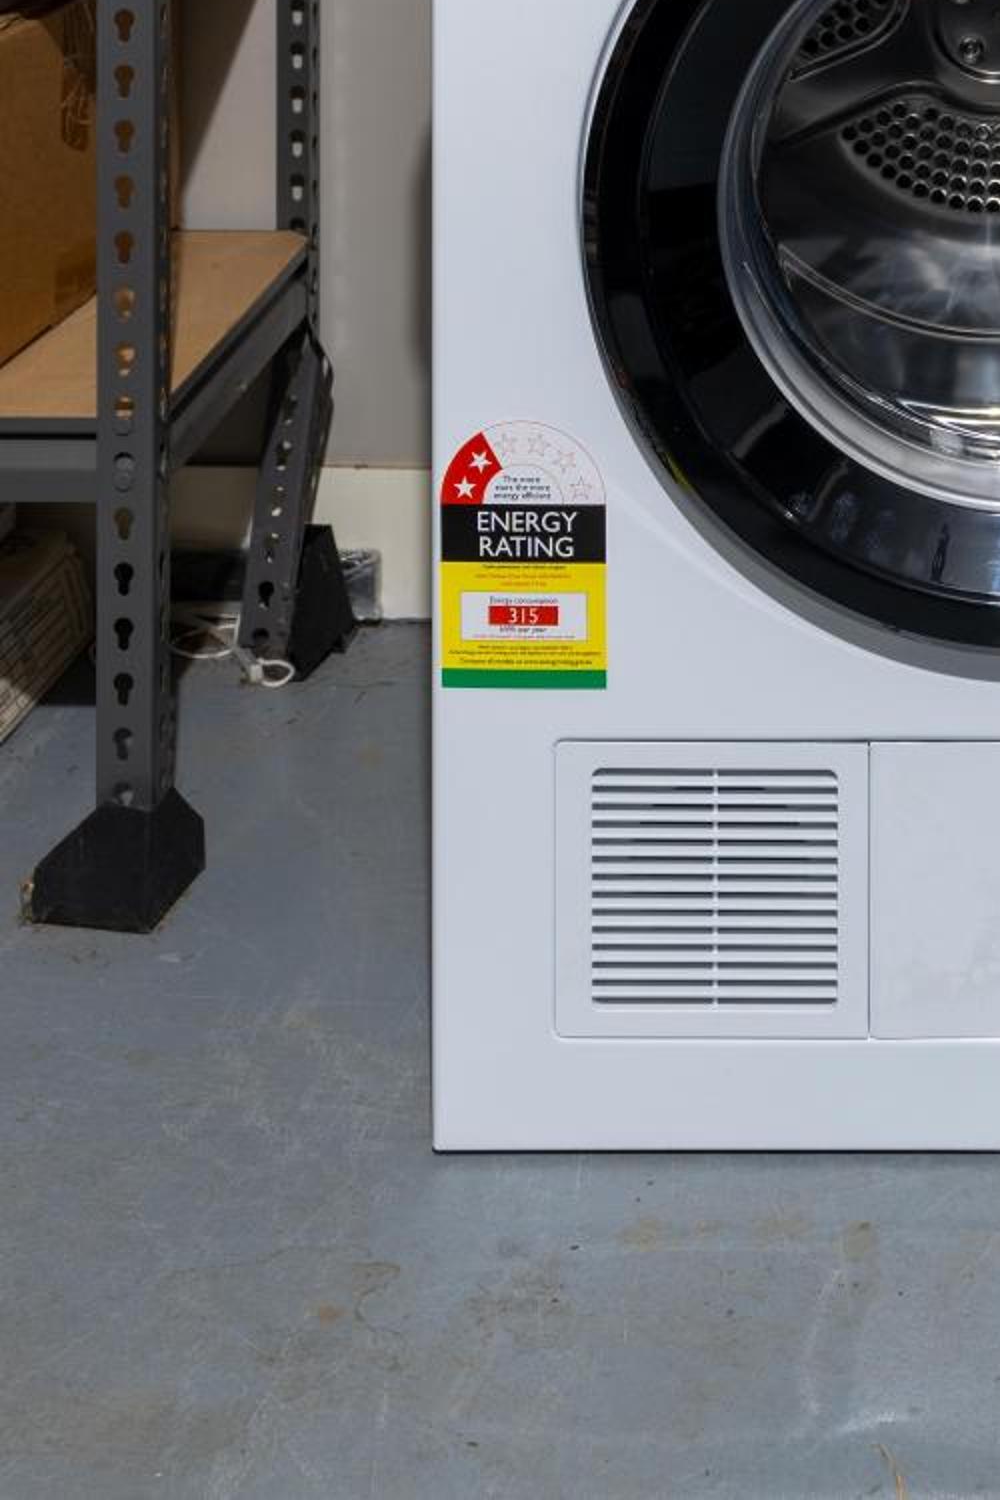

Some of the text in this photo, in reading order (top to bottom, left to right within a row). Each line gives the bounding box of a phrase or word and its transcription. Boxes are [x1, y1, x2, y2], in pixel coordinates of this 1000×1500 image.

[477, 511, 577, 533] ENERGY
[479, 536, 575, 558] RATING
[508, 607, 540, 623] 315
